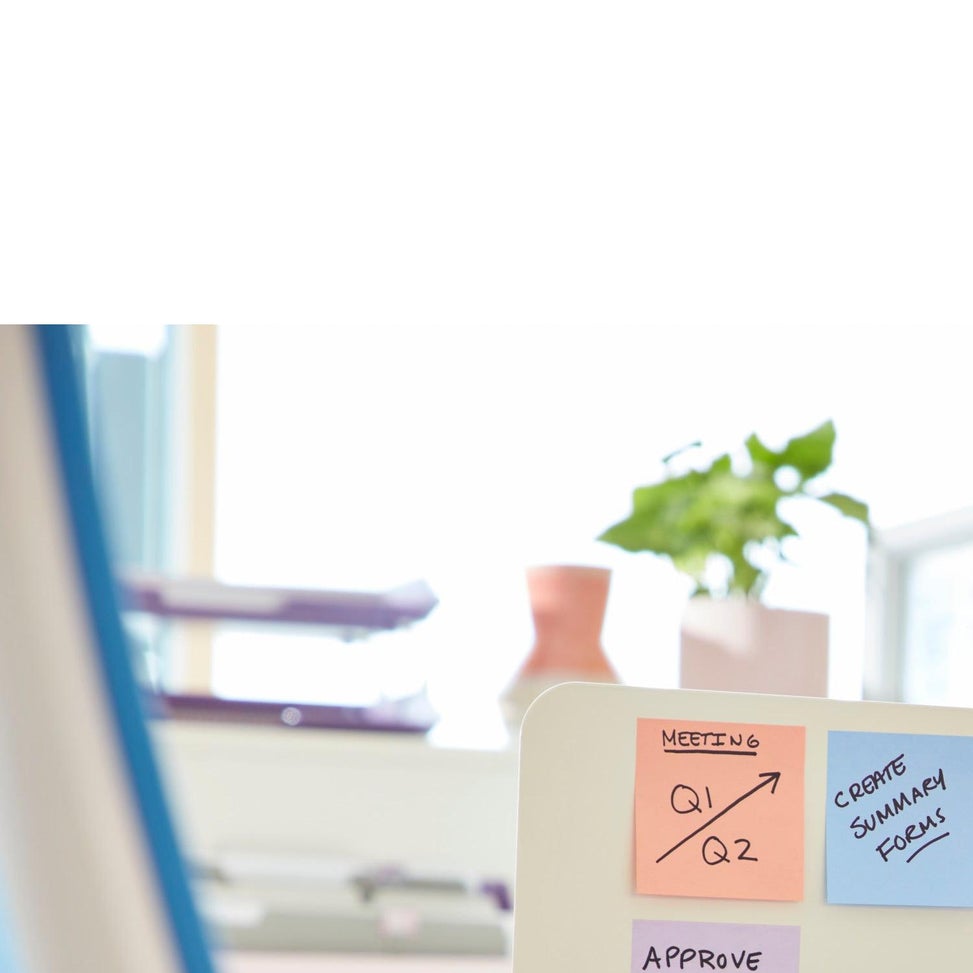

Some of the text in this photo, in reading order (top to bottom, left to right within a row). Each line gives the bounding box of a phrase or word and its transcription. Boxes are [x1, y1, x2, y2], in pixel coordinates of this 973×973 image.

[661, 728, 760, 749] MEETING
[833, 753, 907, 808] CREATE
[670, 783, 713, 815] Q1
[849, 768, 947, 840] SUMMARY
[701, 835, 759, 866] Q2
[875, 807, 946, 863] FORMS
[641, 945, 763, 972] APPROVE
